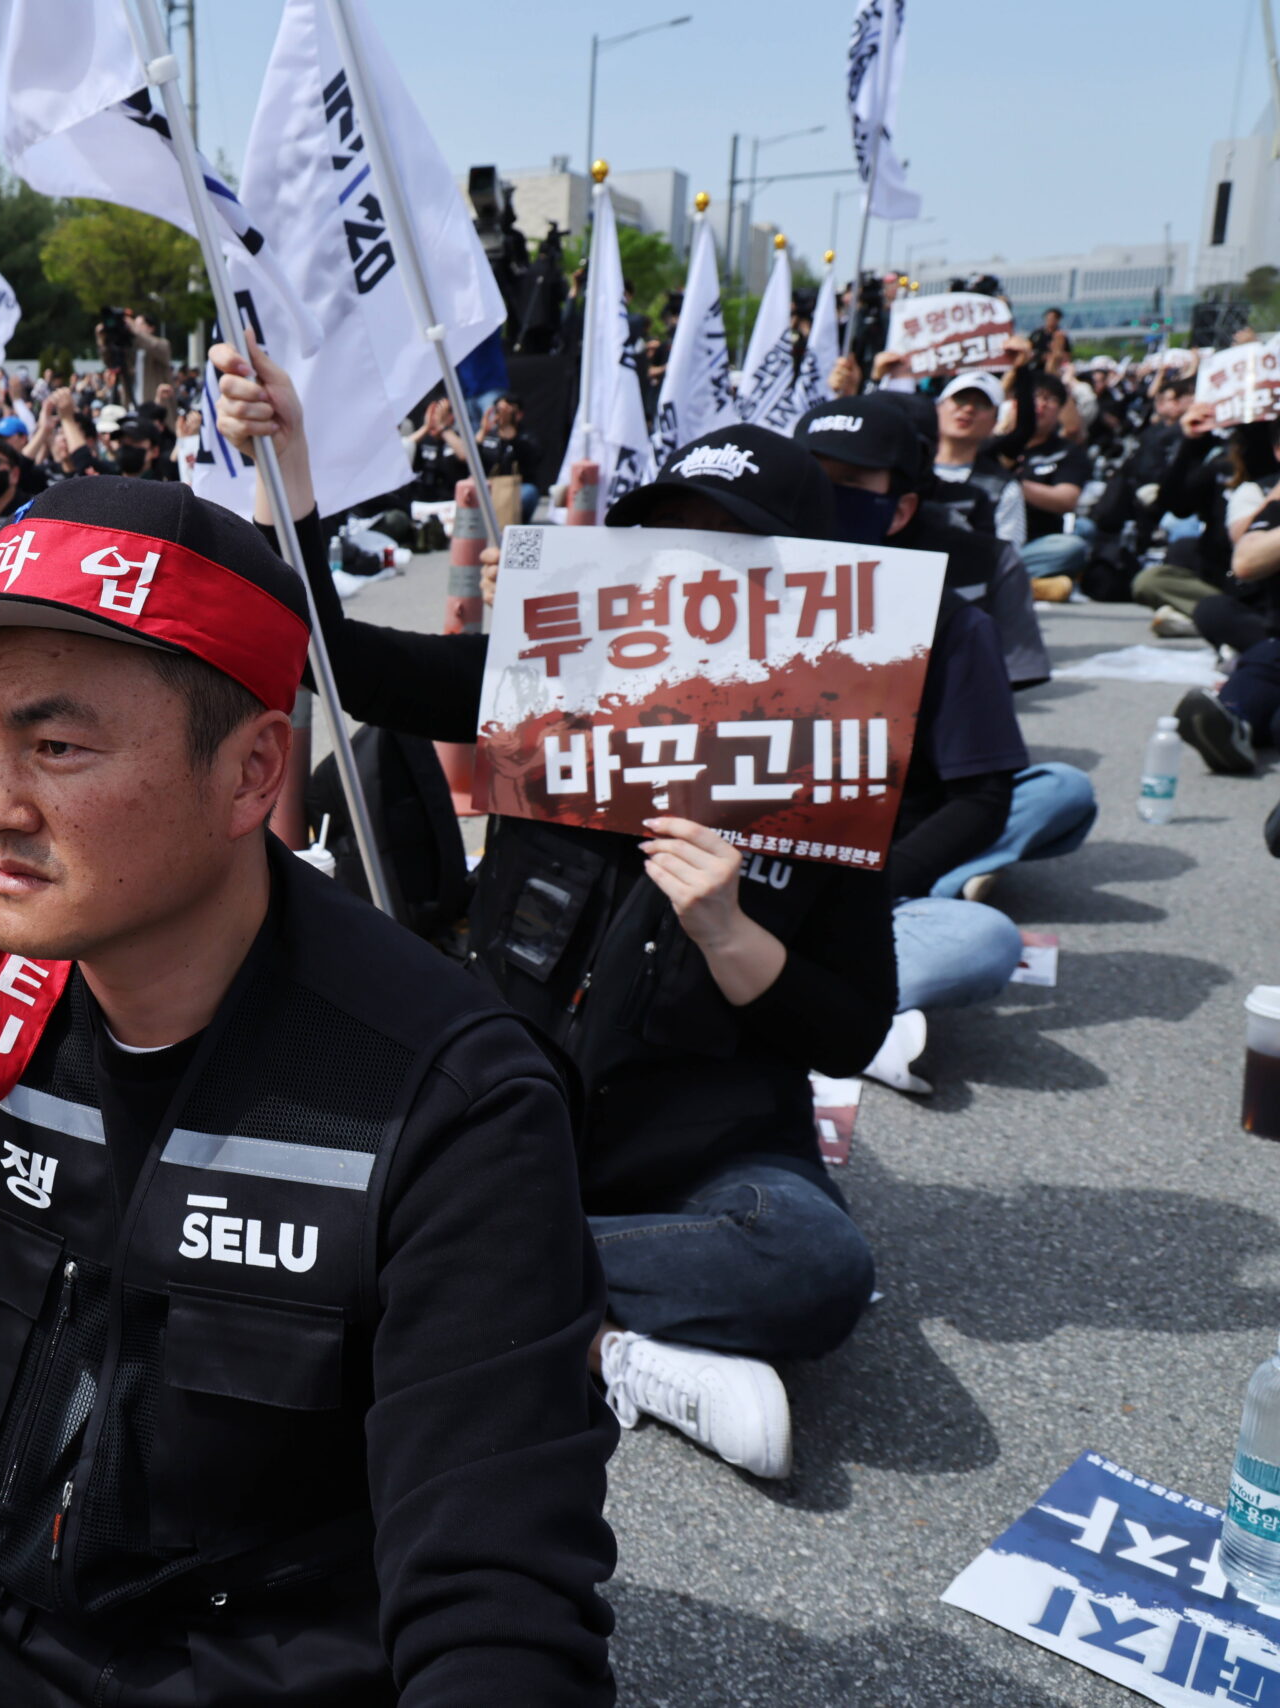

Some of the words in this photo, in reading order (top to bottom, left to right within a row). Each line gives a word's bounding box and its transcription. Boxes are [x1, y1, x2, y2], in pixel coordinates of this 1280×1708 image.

[519, 561, 881, 678] 투명하게
[544, 718, 888, 812] 바꾸고!!!
[795, 840, 881, 866] 공동투쟁본부
[178, 1194, 319, 1274] SELU
